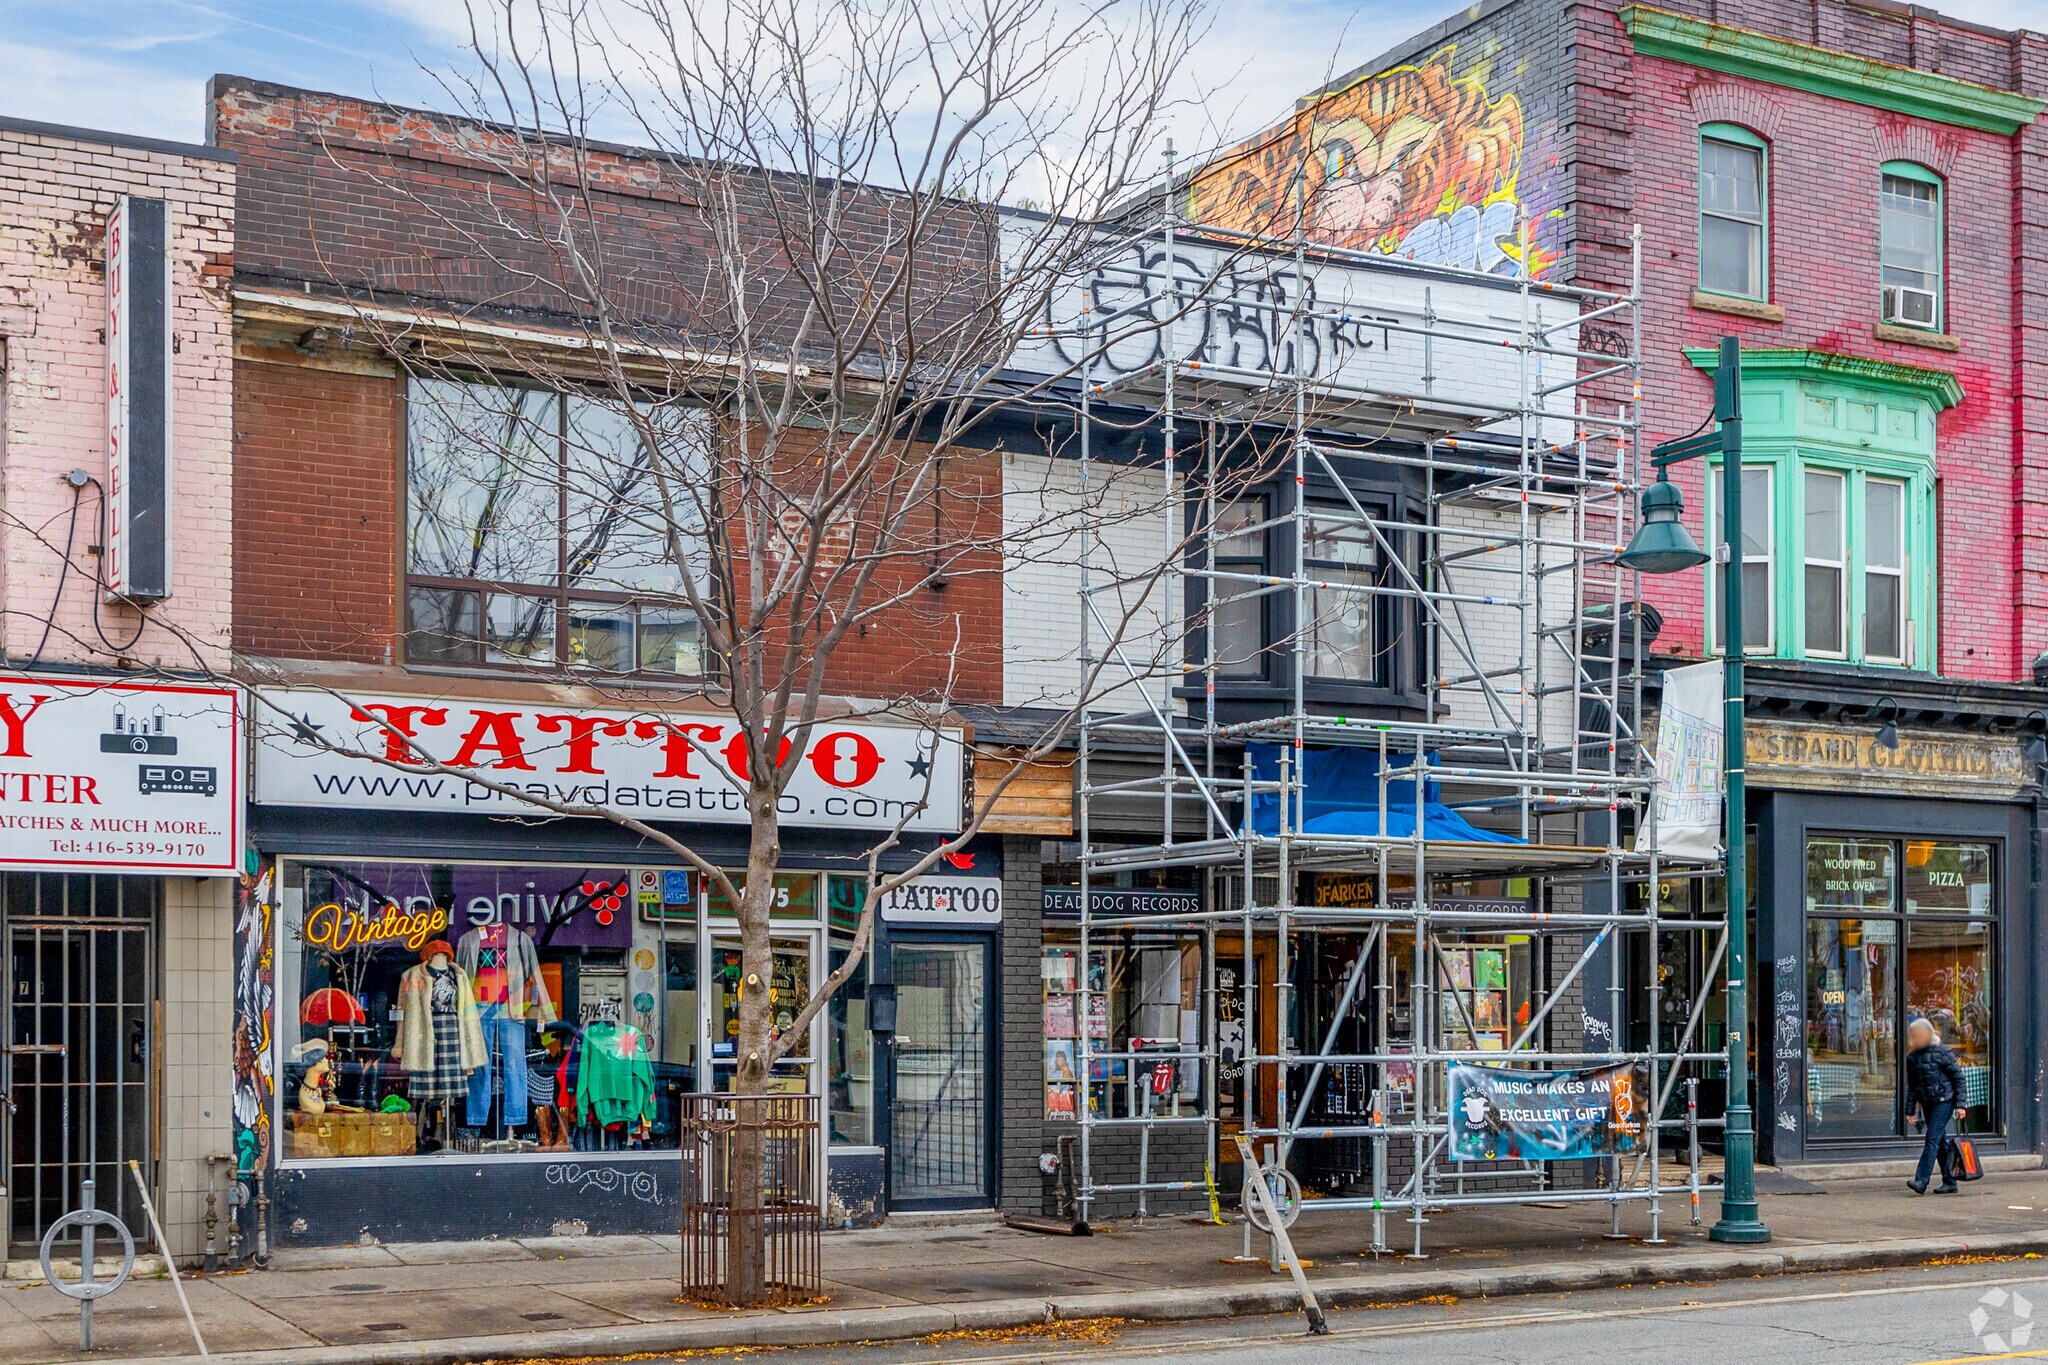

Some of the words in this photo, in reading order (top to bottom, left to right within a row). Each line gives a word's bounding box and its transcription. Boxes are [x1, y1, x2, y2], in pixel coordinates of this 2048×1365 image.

[109, 227, 121, 337] BUY
[110, 363, 120, 399] &
[109, 425, 121, 578] SELL
[350, 702, 886, 789] TATTOO
[1765, 733, 1857, 764] STRAND
[70, 817, 84, 831] &
[91, 818, 148, 833] MUCH
[153, 820, 222, 836] MORE...
[50, 839, 81, 853] Tel:
[84, 840, 205, 857] 416-539-9170
[1824, 858, 1850, 870] WOOD
[1853, 859, 1876, 871] FIRED
[1825, 880, 1850, 891] BRICK
[1852, 880, 1875, 892] OVEN
[1928, 871, 1965, 887] PIZZA
[739, 887, 790, 908] 175
[888, 884, 1001, 912] TATTOO
[1092, 895, 1124, 911] DOG
[1132, 897, 1199, 912] RECORDS
[306, 903, 448, 952] Vintage
[1823, 990, 1845, 1004] OPEN
[1462, 1086, 1476, 1097] DEAD
[1476, 1086, 1488, 1097] DOG
[1492, 1080, 1533, 1095] MUSIC
[1537, 1081, 1585, 1095] MAKES
[1591, 1079, 1611, 1094] AN
[1499, 1108, 1570, 1123] EXCELLENT
[1575, 1106, 1608, 1121] GIFT
[1464, 1120, 1488, 1130] RECORDS
